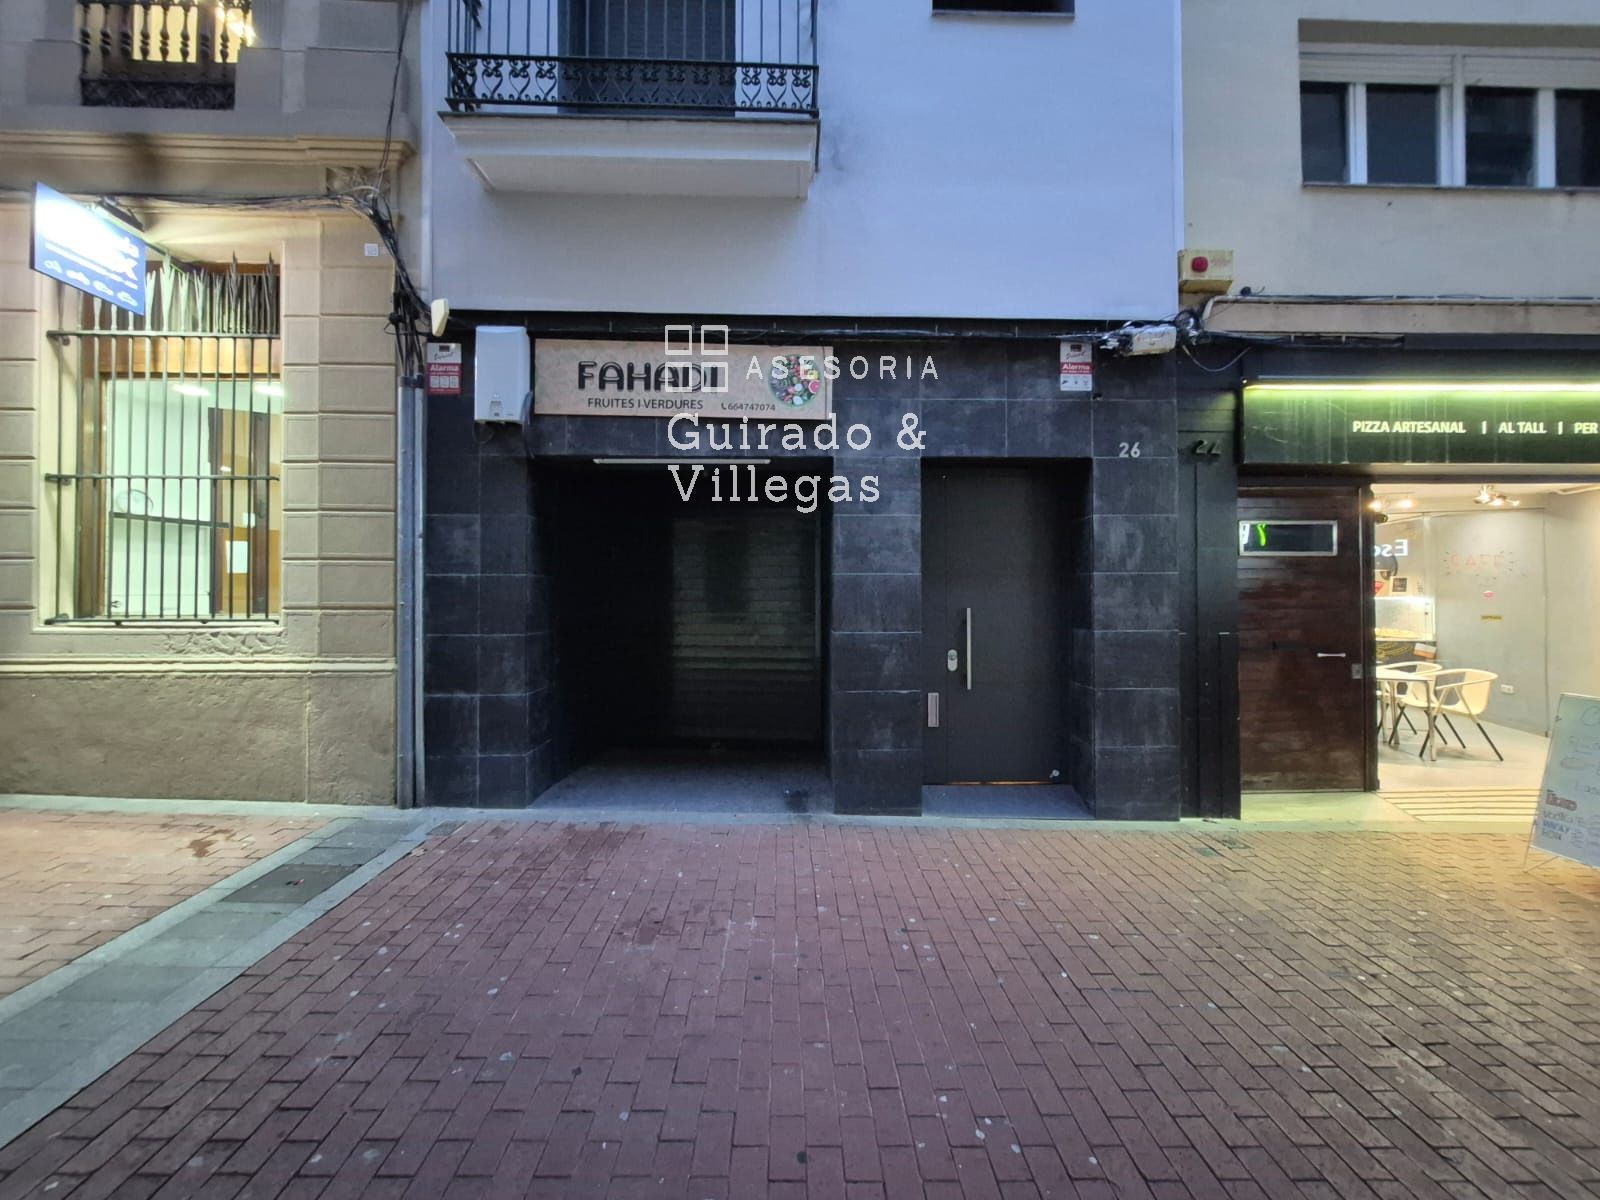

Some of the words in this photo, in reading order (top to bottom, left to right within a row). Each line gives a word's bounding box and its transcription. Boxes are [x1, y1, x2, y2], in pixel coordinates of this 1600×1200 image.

[1062, 363, 1090, 371] Alarma
[578, 361, 718, 392] FAHADI
[588, 398, 635, 408] FRUITES
[642, 399, 703, 410] VERDURES
[1352, 420, 1390, 433] PIZZA
[1391, 420, 1467, 434] ARTESANAL
[1498, 421, 1516, 434] AL
[1516, 421, 1548, 434] TALL
[1573, 421, 1599, 434] PER
[1119, 442, 1141, 458] 26
